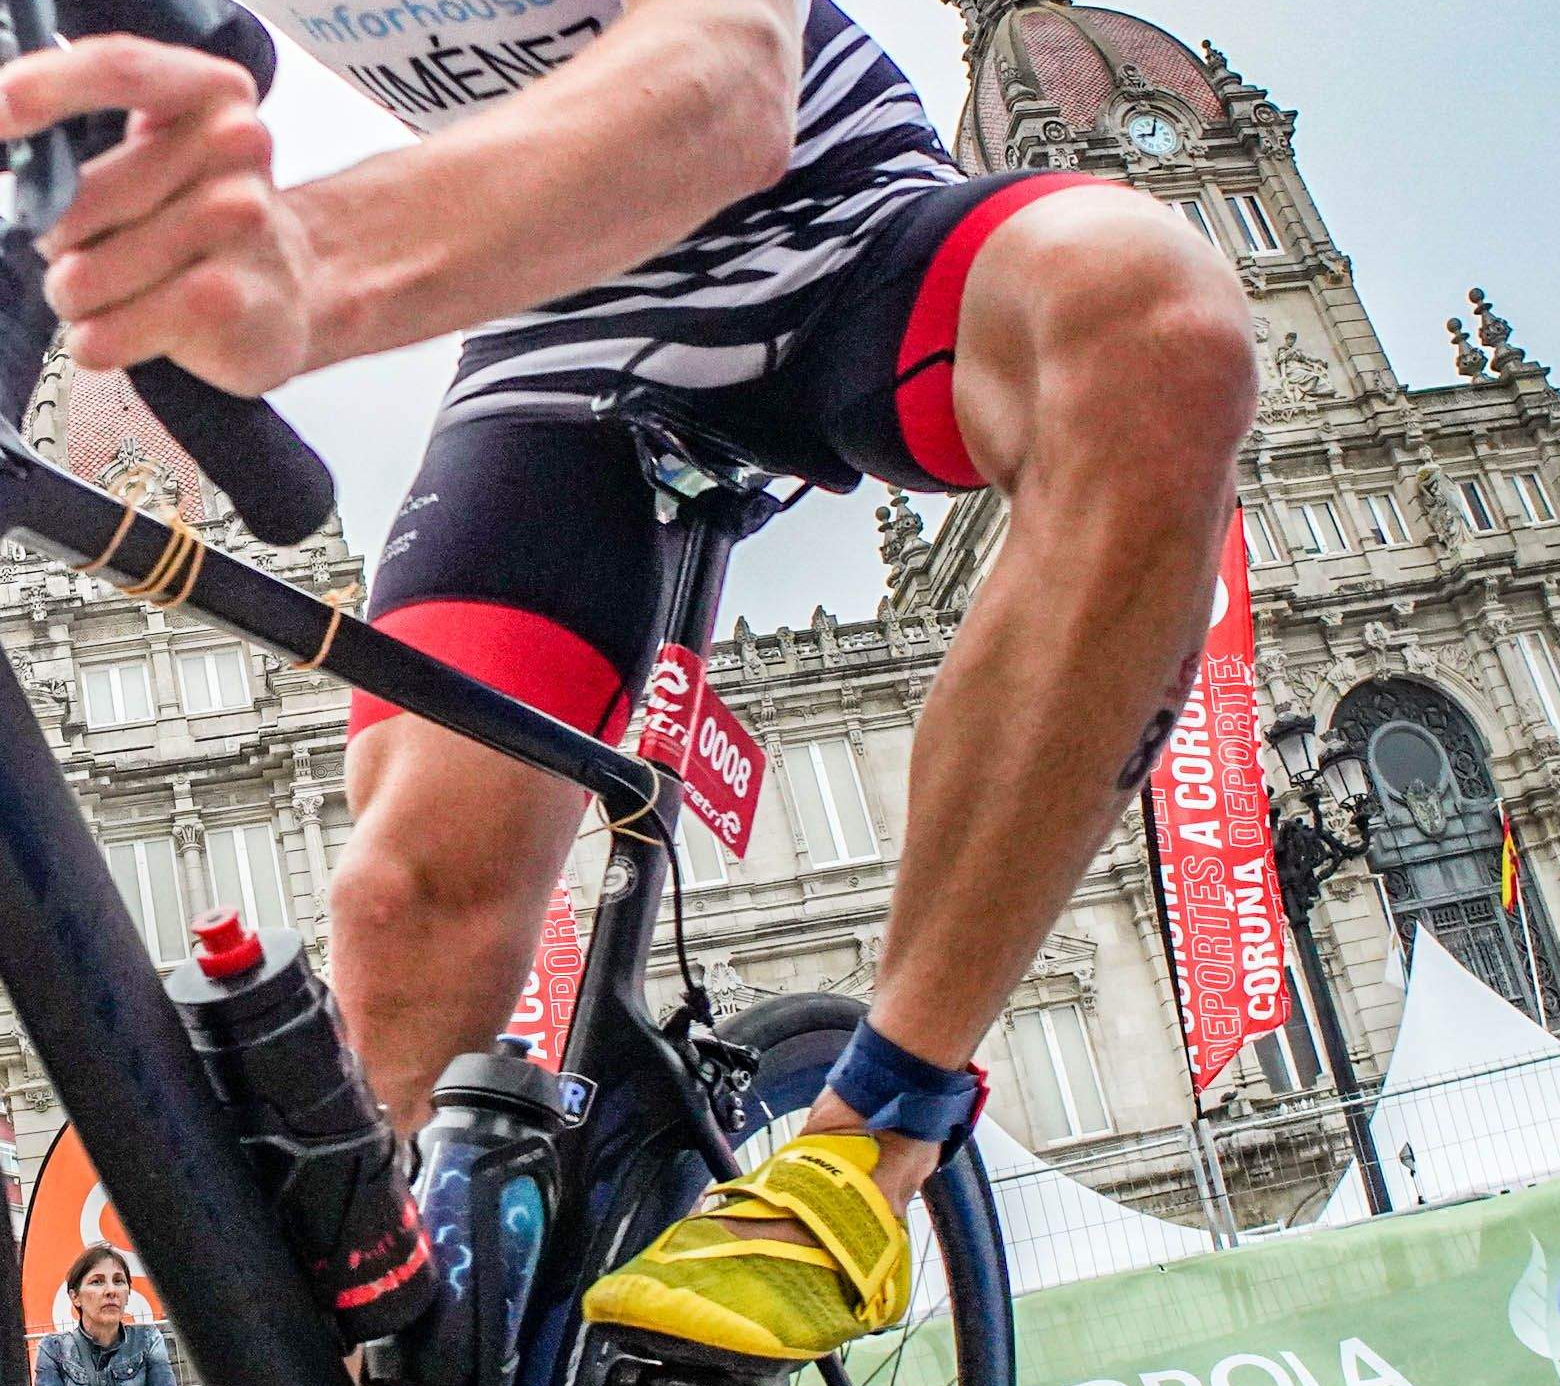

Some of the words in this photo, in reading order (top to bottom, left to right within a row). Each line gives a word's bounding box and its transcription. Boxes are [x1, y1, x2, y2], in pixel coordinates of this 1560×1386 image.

[698, 716, 753, 799] 0008
[1178, 820, 1222, 850] A
[1225, 857, 1280, 1022] CORUÑA
